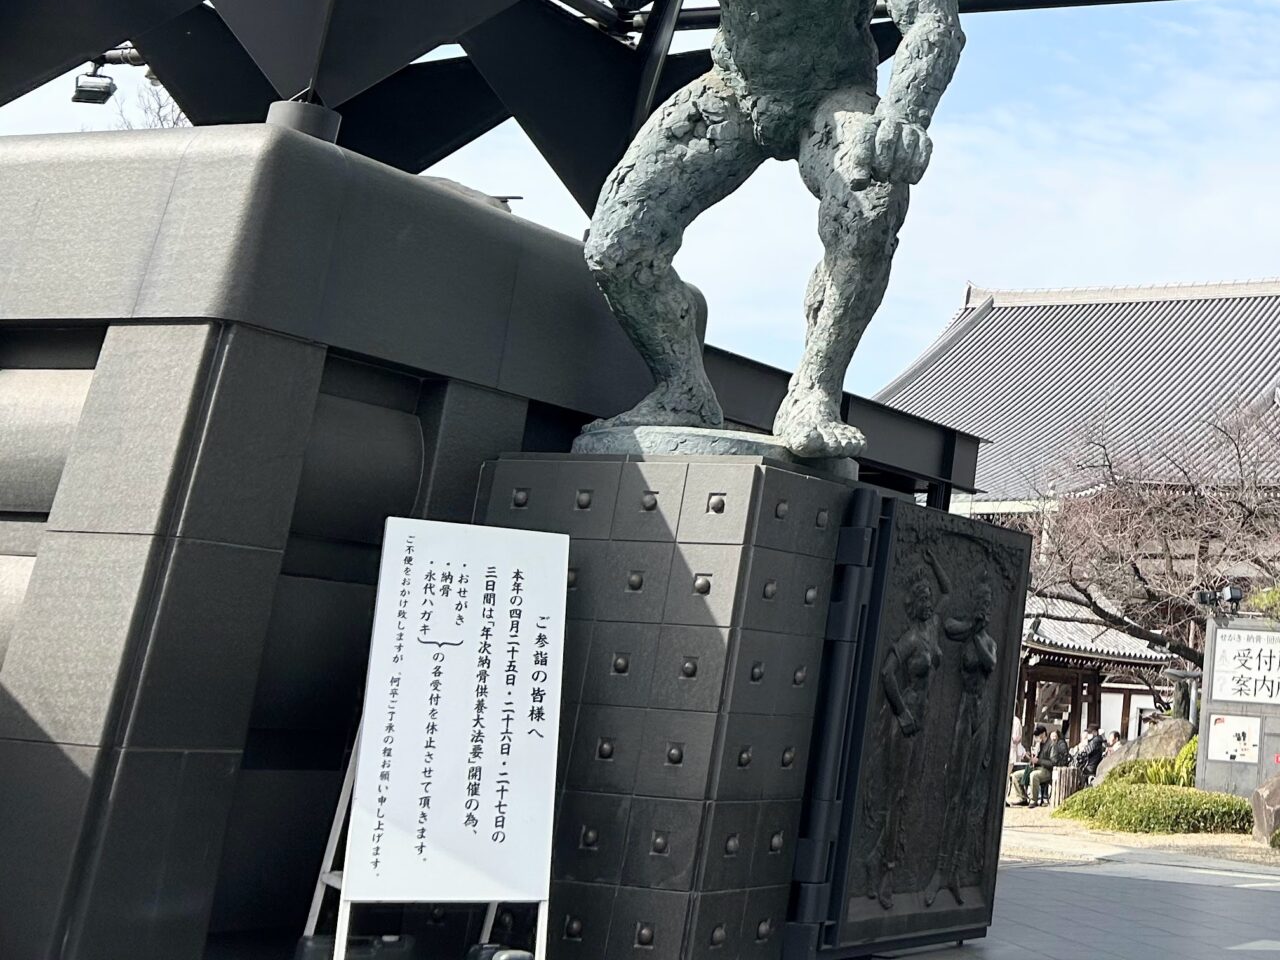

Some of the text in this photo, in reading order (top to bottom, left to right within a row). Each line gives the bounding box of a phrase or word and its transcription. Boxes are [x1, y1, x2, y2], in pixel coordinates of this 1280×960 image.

[414, 652, 445, 862] の各受付を休止させて頂きます。
[463, 566, 498, 835] 三日間は「年次納骨供養大法要」開催の為、
[491, 568, 525, 844] 本年の四月二十五日・二十六日・二十七日の
[527, 615, 550, 739] ご参詣の皆様へ
